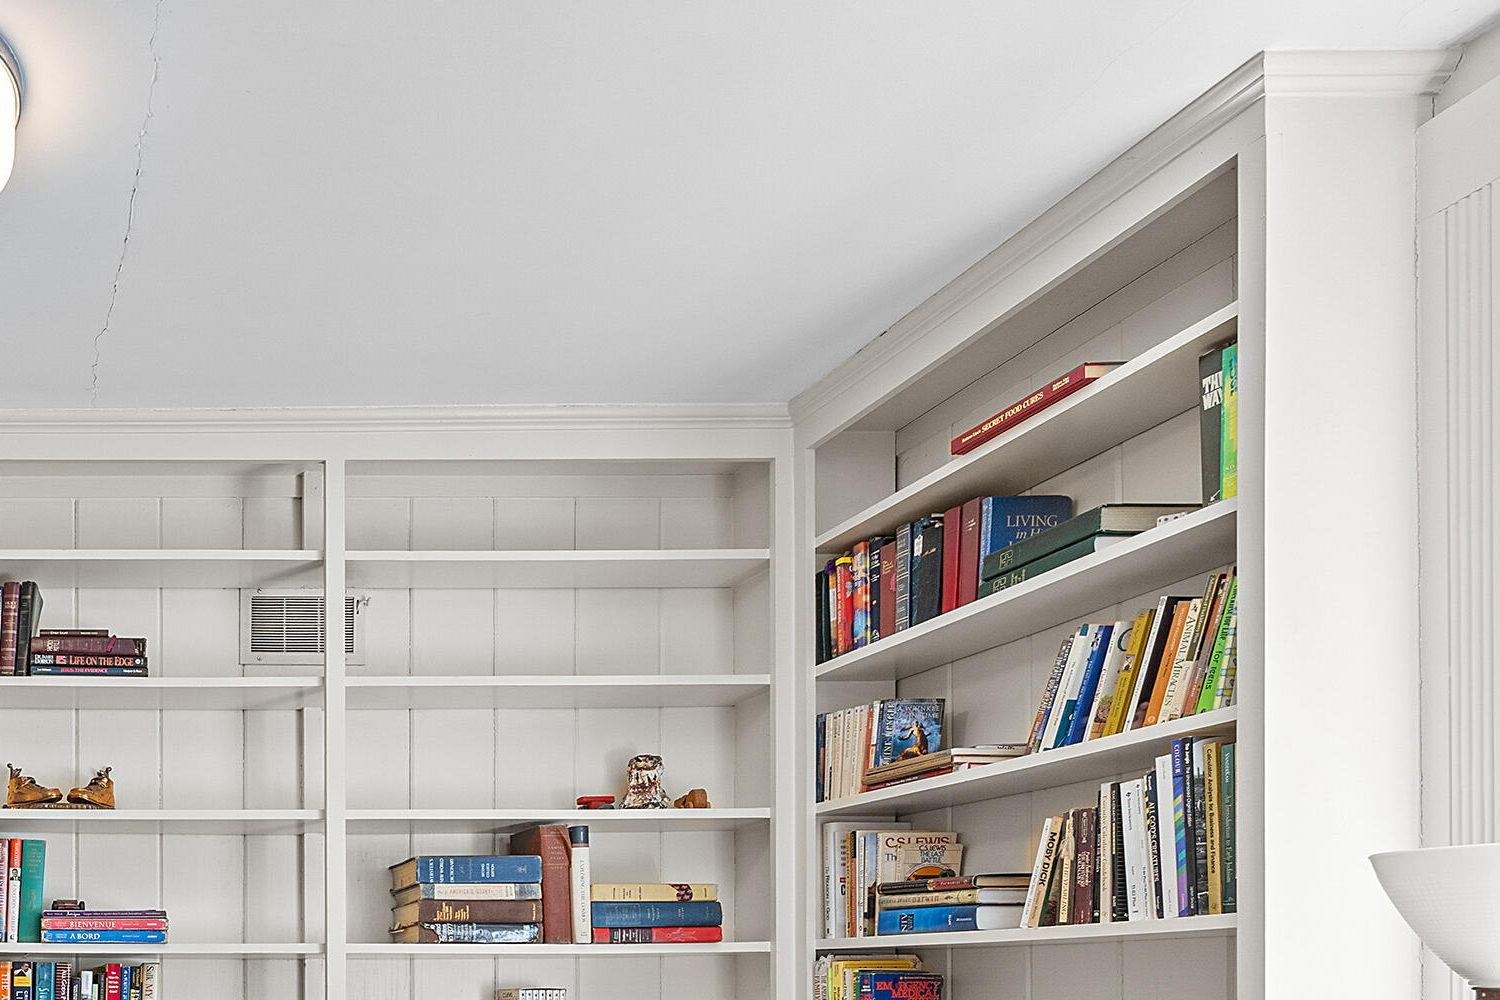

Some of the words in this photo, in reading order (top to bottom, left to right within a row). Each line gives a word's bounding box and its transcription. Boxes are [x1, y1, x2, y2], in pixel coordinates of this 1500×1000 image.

[981, 414, 1004, 432] SECRET
[1004, 405, 1022, 419] FOOD
[1023, 392, 1044, 408] CURES
[1007, 515, 1058, 527] LIVING
[1178, 615, 1197, 657] ANIMAL
[69, 656, 85, 665] LIFE
[86, 656, 97, 665] ON
[99, 657, 113, 665] THE
[114, 657, 134, 666] EDGE
[1213, 650, 1223, 662] for
[1164, 658, 1184, 706] MIRACLES
[1205, 666, 1217, 690] teens
[1173, 744, 1181, 774] COLOUR
[1206, 748, 1214, 777] Calculator
[1207, 779, 1215, 802] Analysis
[1225, 794, 1230, 803] An
[1149, 817, 1157, 839] GOD'S
[1044, 832, 1058, 860] MOBY
[1151, 840, 1159, 883] CREATURES
[1039, 862, 1051, 887] DICK
[1061, 878, 1069, 915] YEARLING
[900, 913, 908, 932] NIV
[146, 966, 154, 981] Salk
[145, 984, 153, 999] MY
[892, 989, 939, 998] MEDICAL
